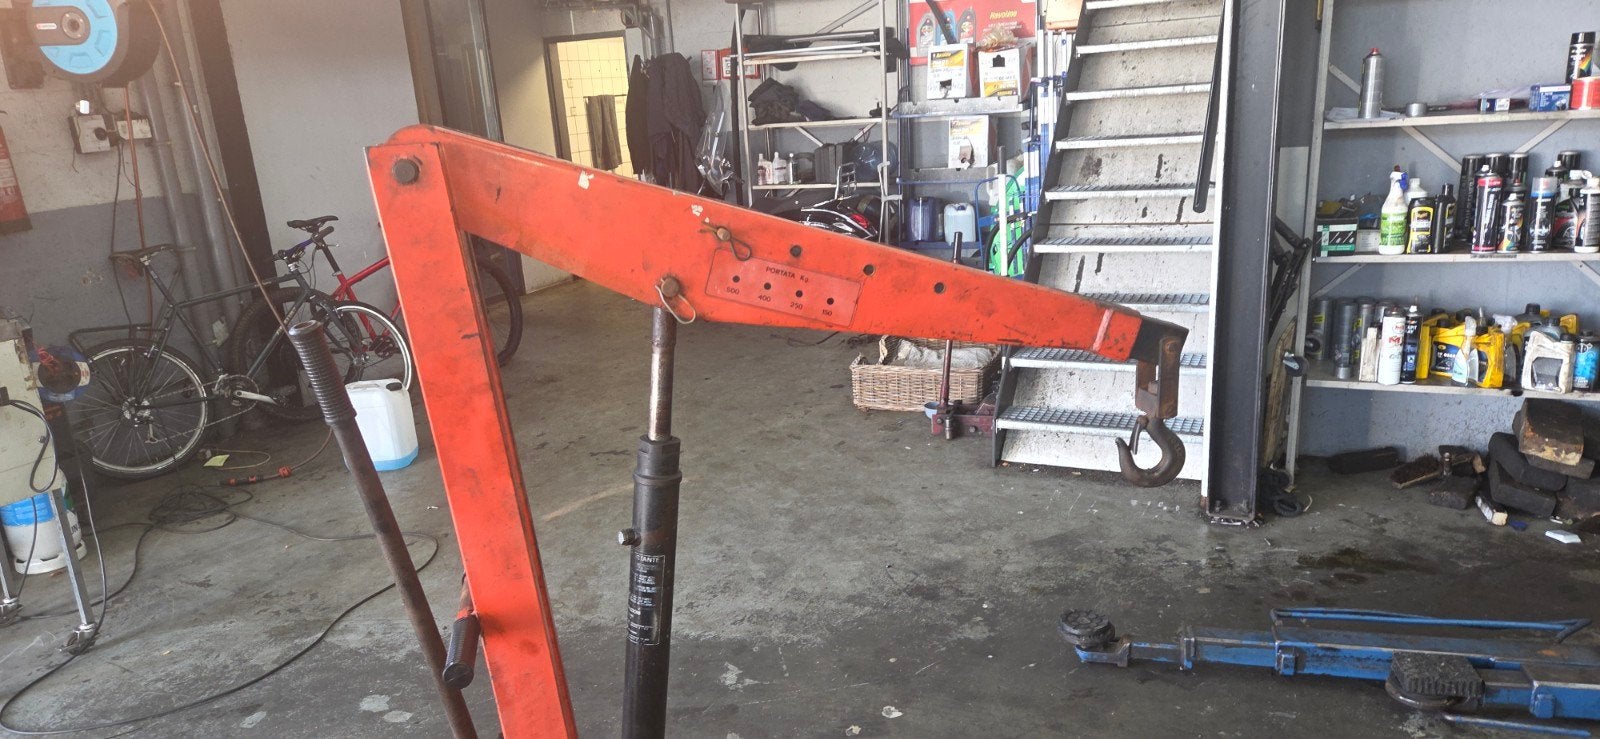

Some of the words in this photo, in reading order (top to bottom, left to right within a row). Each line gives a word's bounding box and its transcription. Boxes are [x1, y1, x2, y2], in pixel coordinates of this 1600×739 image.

[766, 266, 796, 279] PORTATA
[726, 286, 740, 295] 500
[758, 294, 771, 303] 400
[790, 302, 804, 310] 250
[822, 309, 833, 317] 150
